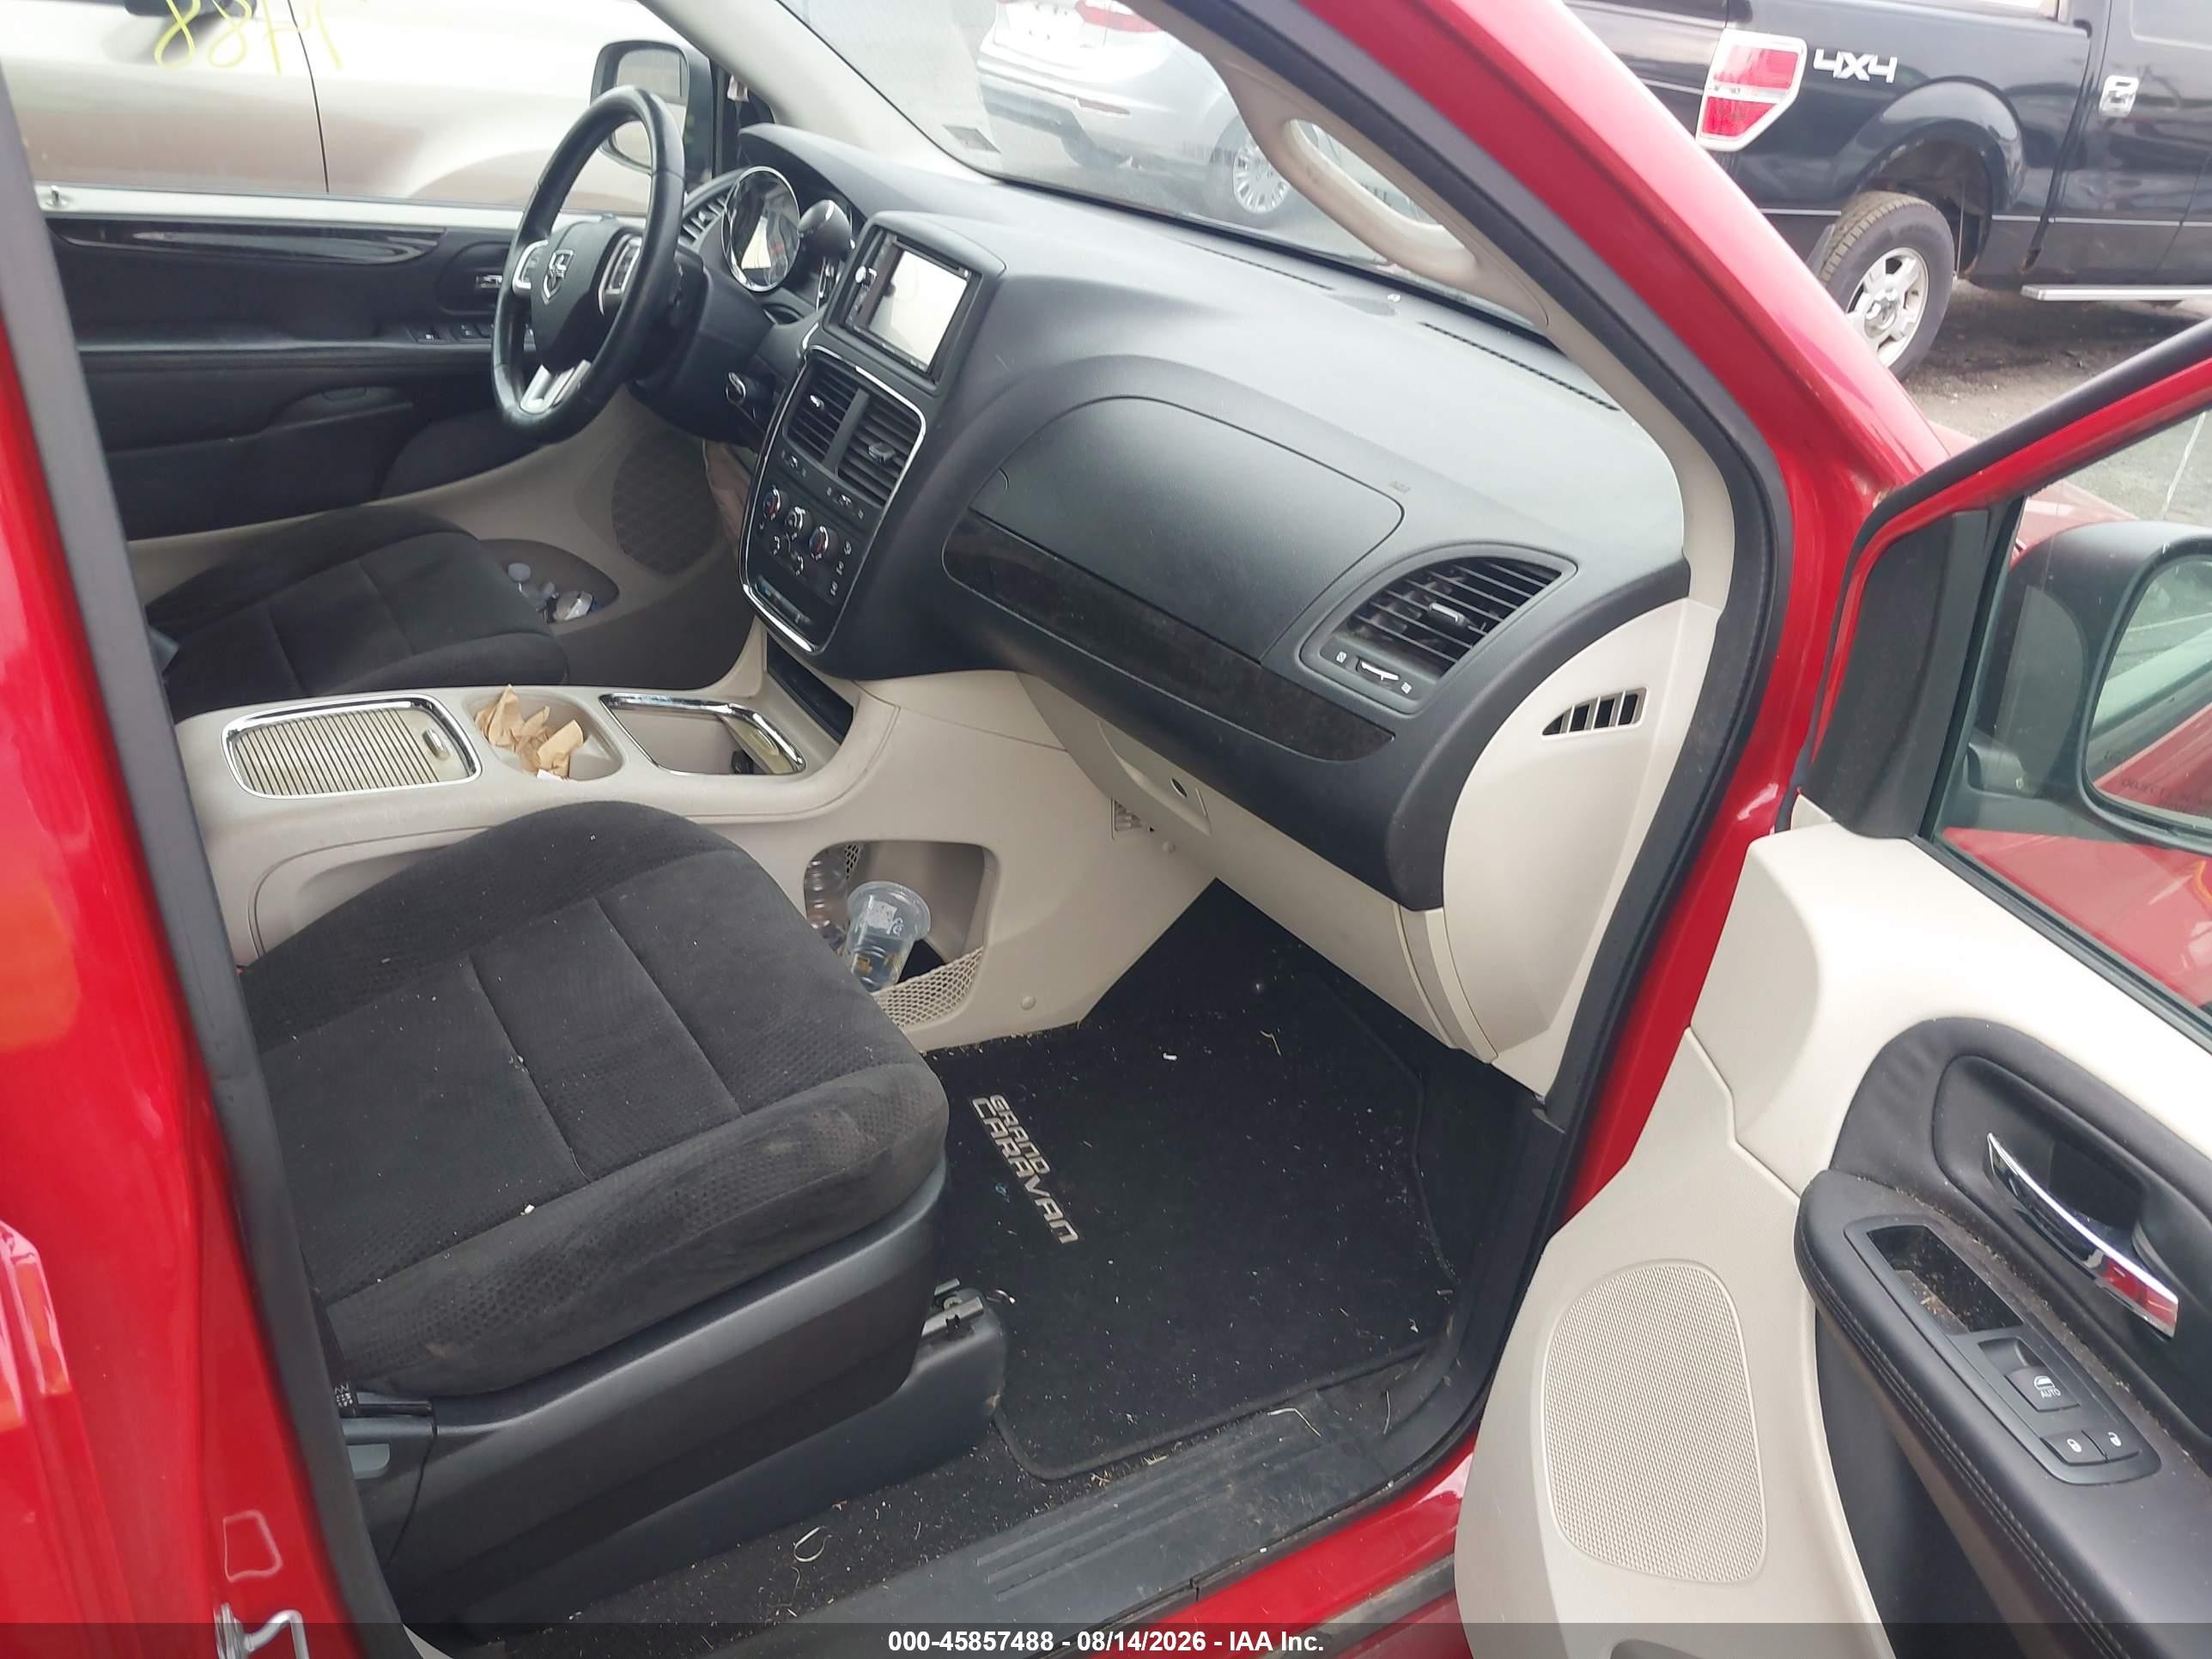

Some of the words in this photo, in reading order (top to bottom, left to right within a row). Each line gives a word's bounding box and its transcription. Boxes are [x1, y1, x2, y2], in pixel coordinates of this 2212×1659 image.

[971, 1097, 1079, 1244] CARAVAN
[989, 1093, 1051, 1176] GRAND
[2039, 1387, 2062, 1399] AUTO
